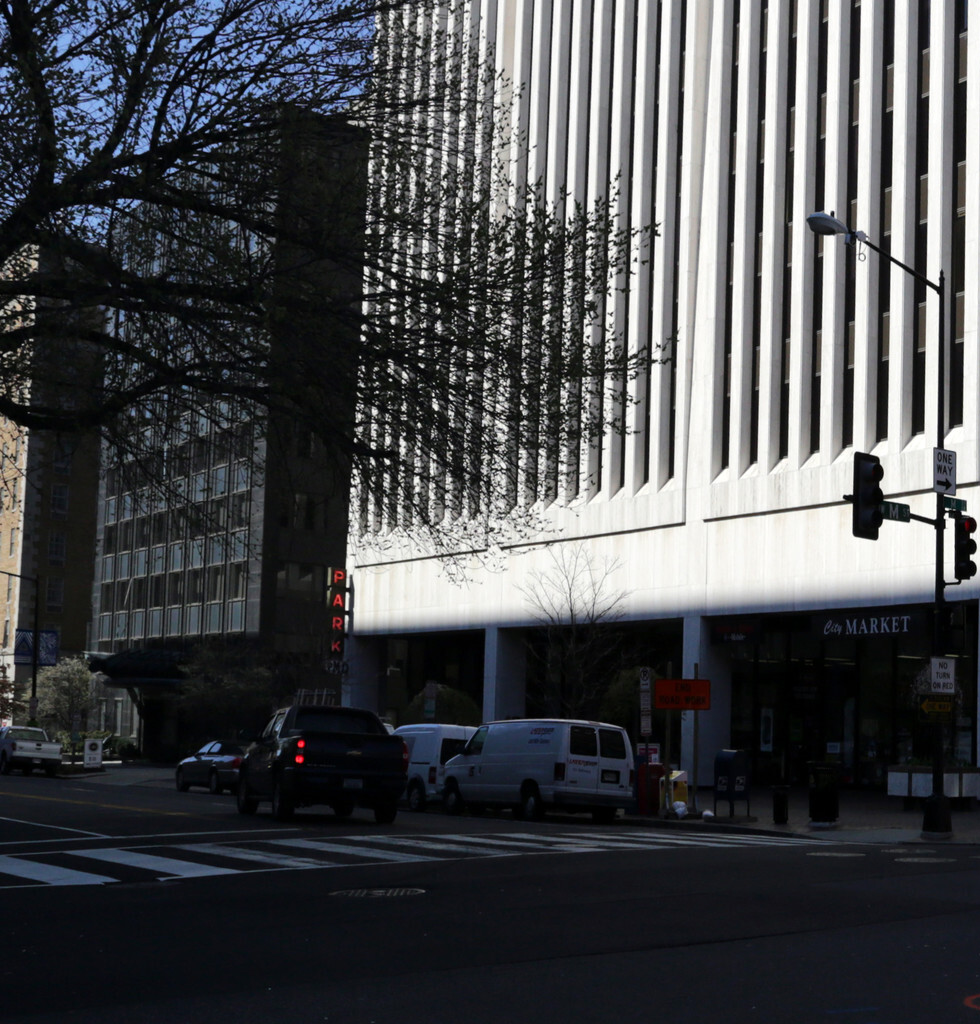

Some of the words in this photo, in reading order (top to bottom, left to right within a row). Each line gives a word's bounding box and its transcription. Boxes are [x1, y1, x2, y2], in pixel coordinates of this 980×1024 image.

[937, 452, 953, 464] ONE
[936, 464, 953, 476] WAY
[331, 570, 346, 653] PARK
[823, 619, 843, 636] City
[845, 615, 911, 635] MARKET
[938, 662, 948, 670] NO
[936, 671, 950, 680] TURN
[933, 682, 941, 690] ON
[942, 682, 953, 691] RED
